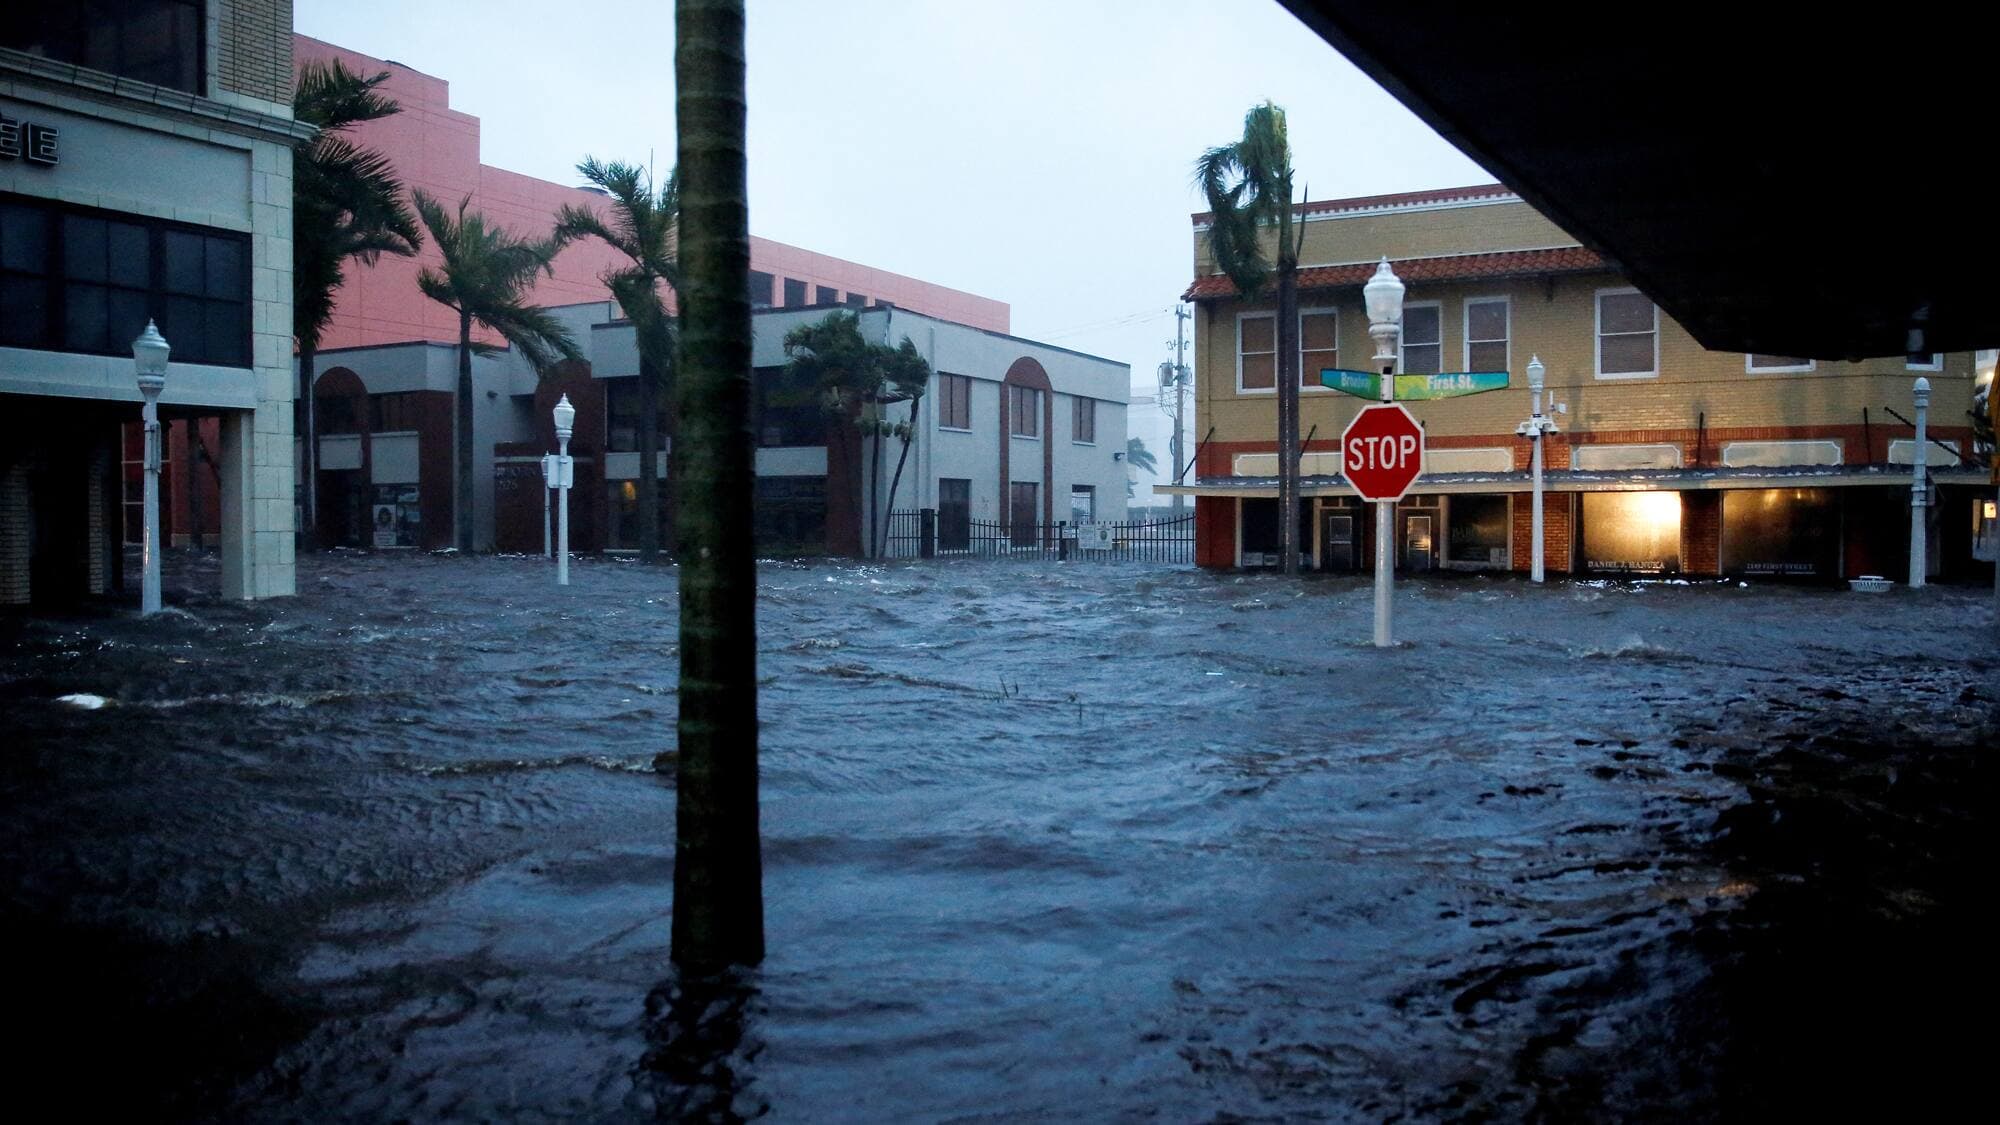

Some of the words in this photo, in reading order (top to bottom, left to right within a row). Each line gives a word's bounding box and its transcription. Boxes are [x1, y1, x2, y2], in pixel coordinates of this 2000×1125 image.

[1427, 375, 1453, 390] First
[1457, 375, 1475, 389] St.
[1348, 435, 1417, 471] STOP
[1587, 560, 1619, 568] DANIEL
